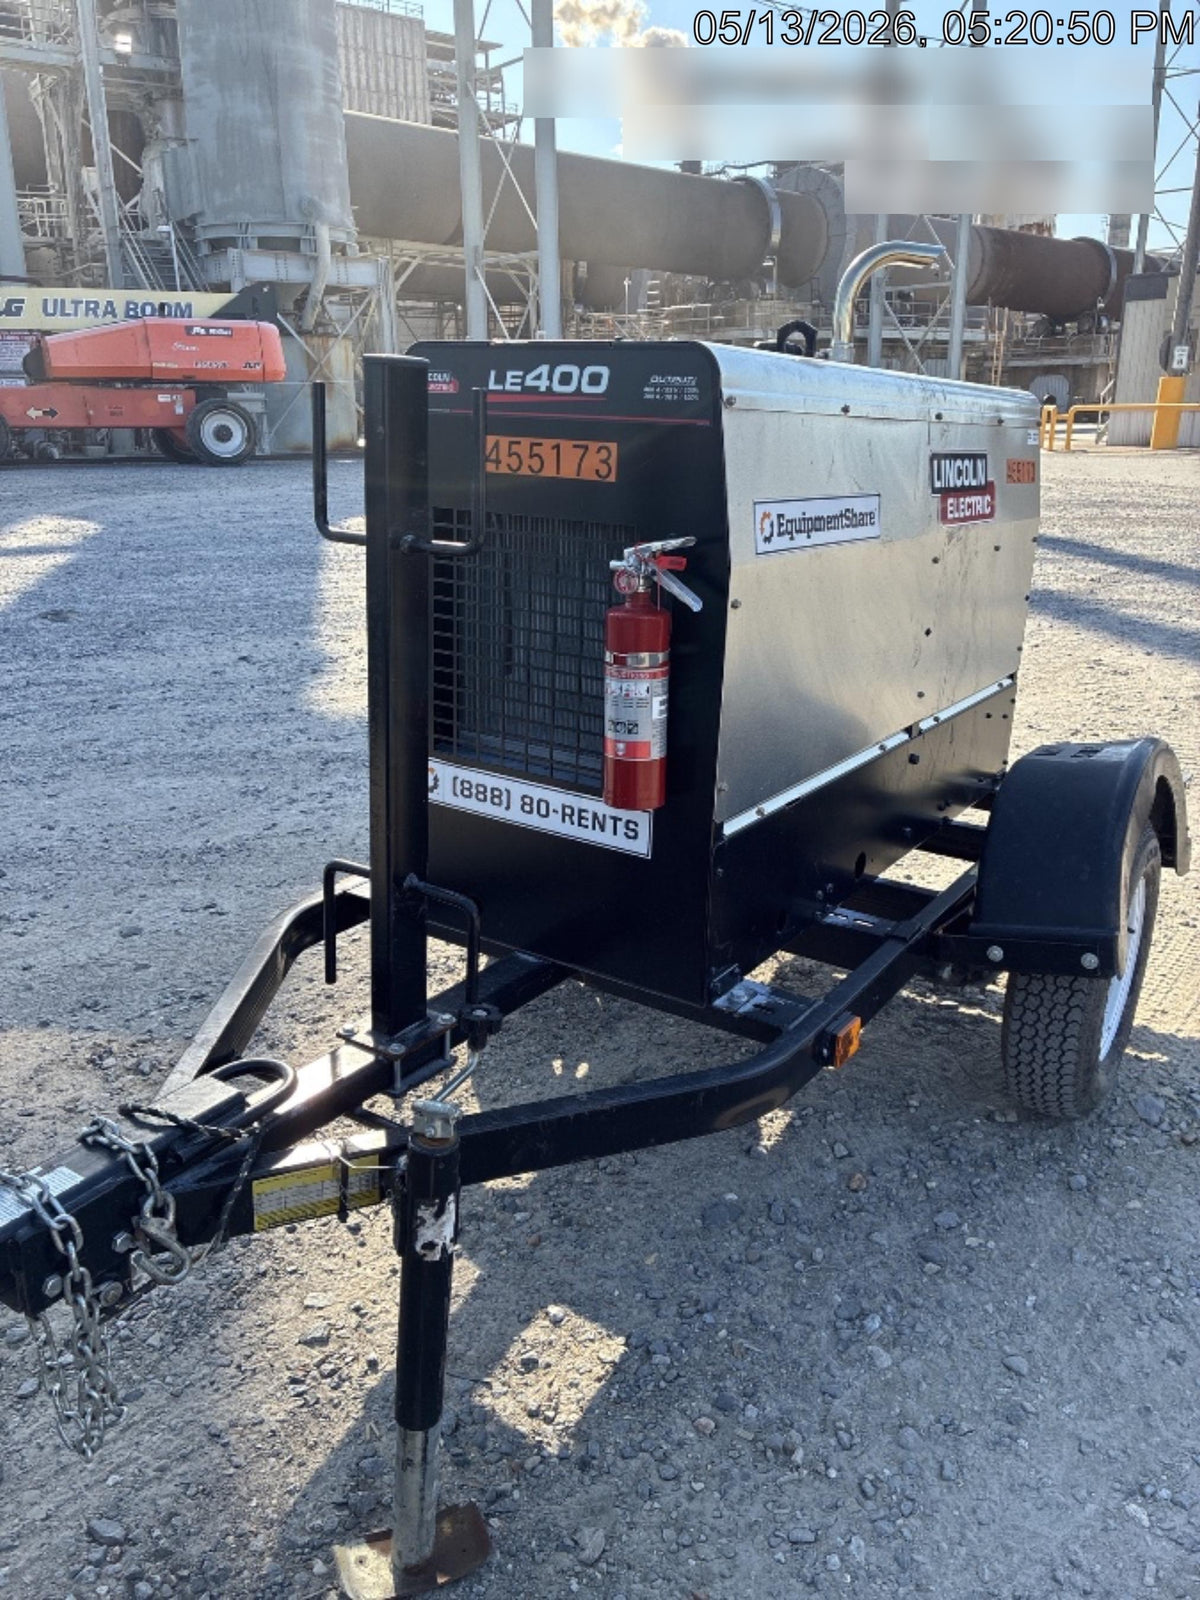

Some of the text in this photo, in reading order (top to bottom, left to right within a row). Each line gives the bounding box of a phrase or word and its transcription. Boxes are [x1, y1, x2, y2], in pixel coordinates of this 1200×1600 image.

[41, 298, 118, 319] ULTRA
[123, 300, 193, 319] BOOM
[487, 363, 611, 394] LE400
[485, 438, 613, 480] 455173
[933, 458, 986, 488] LINCOLN
[947, 494, 992, 519] ELECTRIC
[776, 507, 876, 542] EquipmentShare
[452, 775, 640, 841] (888) 80-RENTS
